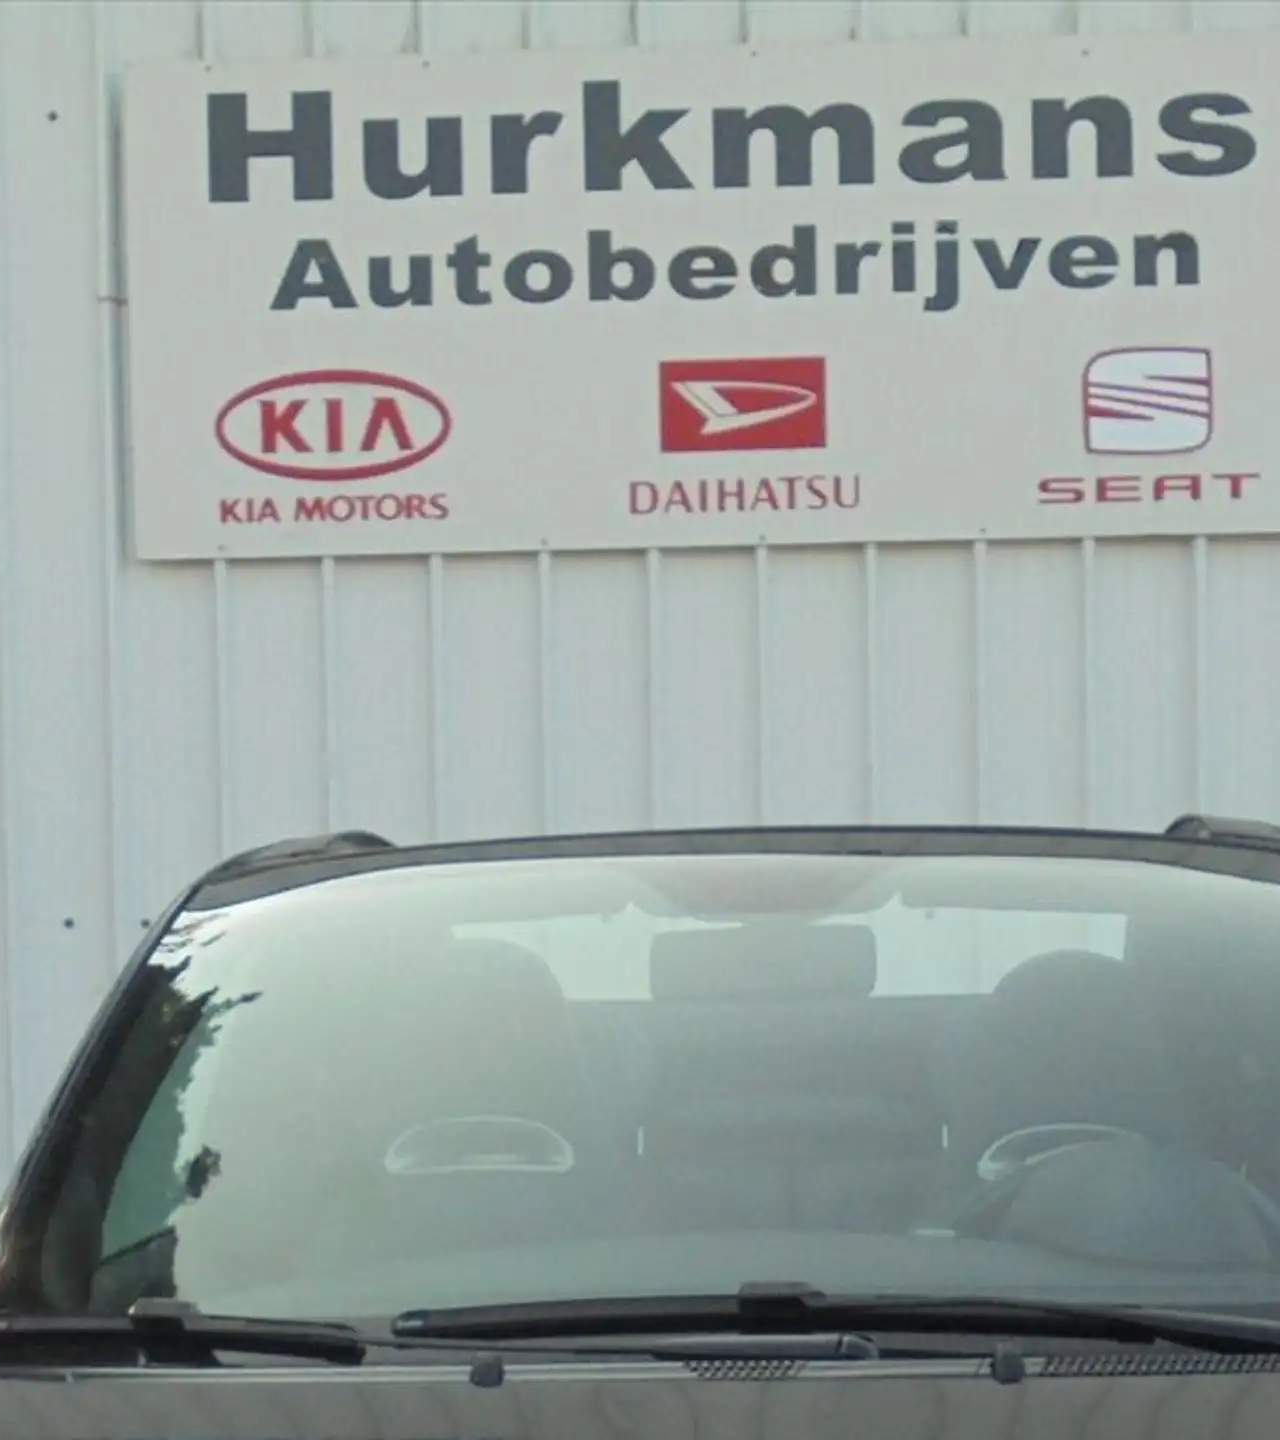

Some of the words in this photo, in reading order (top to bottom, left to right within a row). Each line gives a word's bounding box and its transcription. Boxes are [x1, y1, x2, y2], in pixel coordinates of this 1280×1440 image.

[206, 80, 1258, 203] Hurkmans
[269, 220, 1201, 312] Autobedrijven
[258, 397, 414, 455] KIA
[219, 496, 281, 525] KIA
[294, 493, 450, 523] MOTORS
[628, 475, 861, 516] DAIHATSU
[1037, 473, 1261, 505] SEAT
